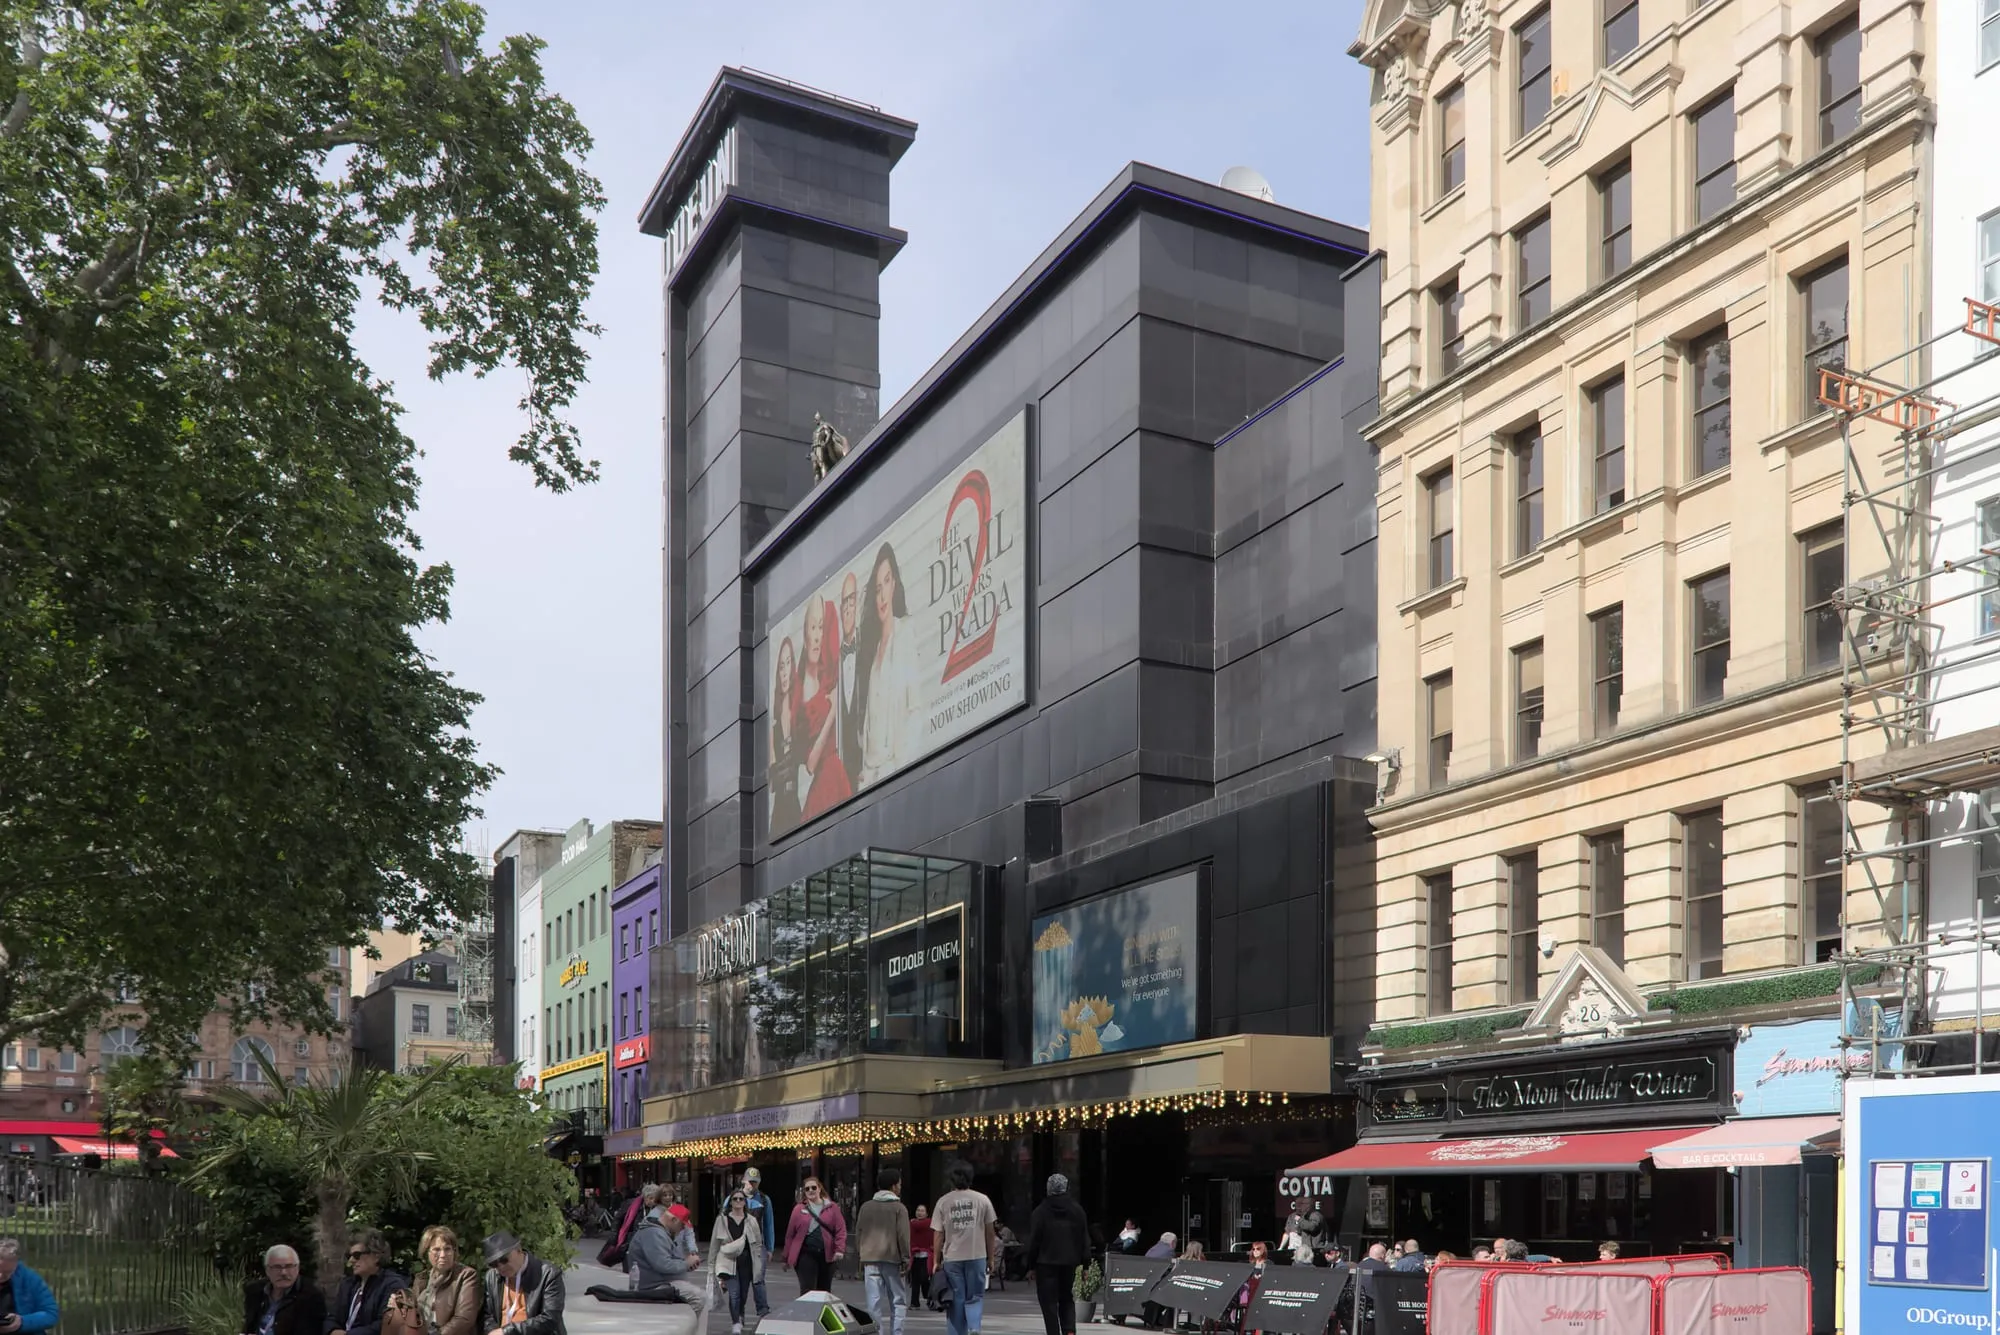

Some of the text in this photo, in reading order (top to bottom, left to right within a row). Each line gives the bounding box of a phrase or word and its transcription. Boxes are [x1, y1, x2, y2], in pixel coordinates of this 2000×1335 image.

[935, 522, 960, 556] THE
[928, 508, 1013, 608] DEVIL
[938, 580, 1013, 656] PRADA
[929, 672, 1011, 734] NOW SHOWING
[1140, 974, 1150, 987] got
[1150, 967, 1183, 982] something
[1142, 986, 1170, 1001] everyone
[1580, 1004, 1601, 1023] 28
[1472, 1064, 1697, 1109] The Moon Under Water
[1682, 1155, 1701, 1165] BAR
[1711, 1152, 1765, 1163] COCKTAILS
[1278, 1176, 1333, 1198] COSTA
[1540, 1304, 1607, 1323] Simmons
[1709, 1302, 1769, 1320] Simmons
